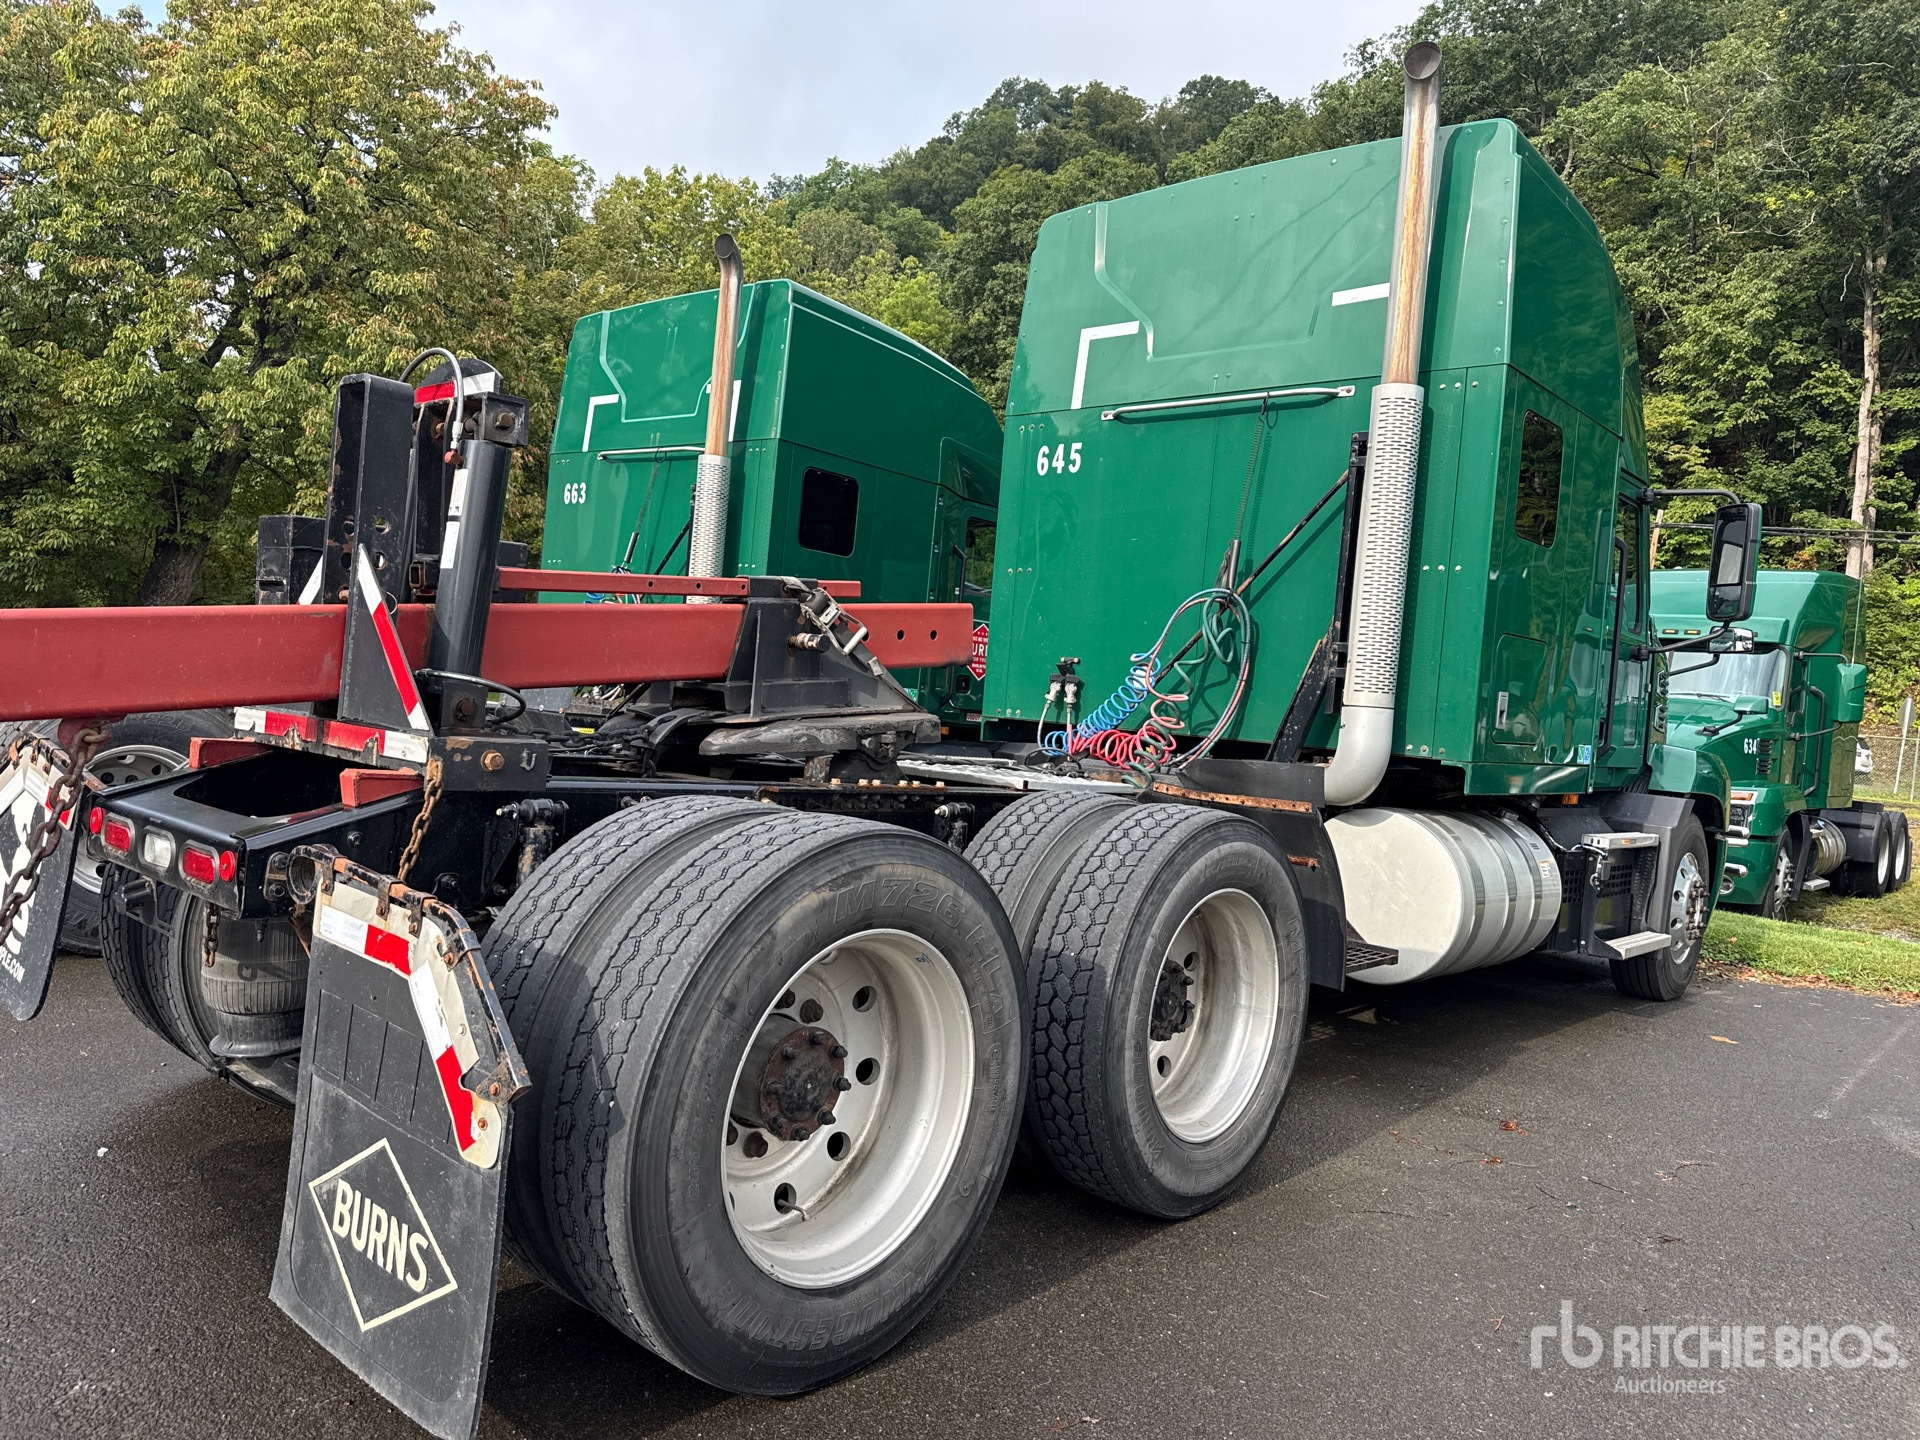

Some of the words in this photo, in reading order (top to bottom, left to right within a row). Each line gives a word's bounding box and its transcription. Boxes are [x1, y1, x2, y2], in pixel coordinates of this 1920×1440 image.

[1036, 442, 1083, 476] 645
[563, 482, 586, 504] 663
[834, 878, 966, 928] M726
[0, 945, 26, 983] PLE.COM
[332, 1178, 430, 1293] BURNS
